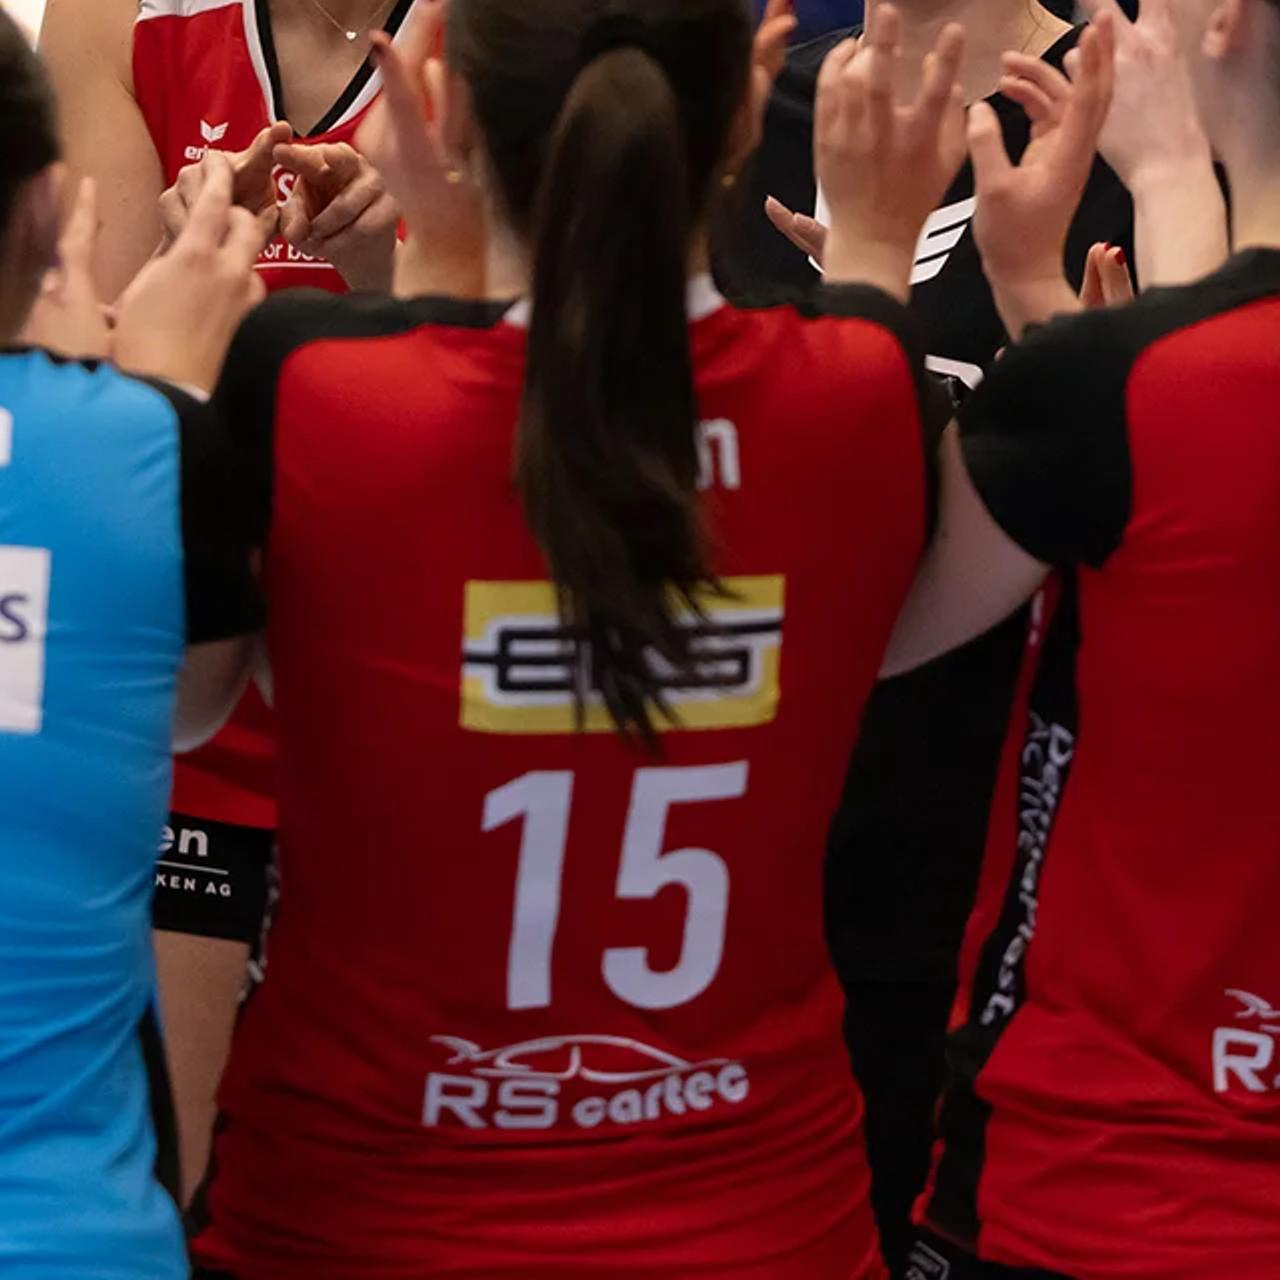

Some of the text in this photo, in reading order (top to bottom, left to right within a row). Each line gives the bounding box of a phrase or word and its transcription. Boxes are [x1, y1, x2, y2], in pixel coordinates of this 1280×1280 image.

[205, 881, 232, 897] AG
[481, 760, 750, 1010] 15
[422, 1062, 750, 1129] RS cartec
